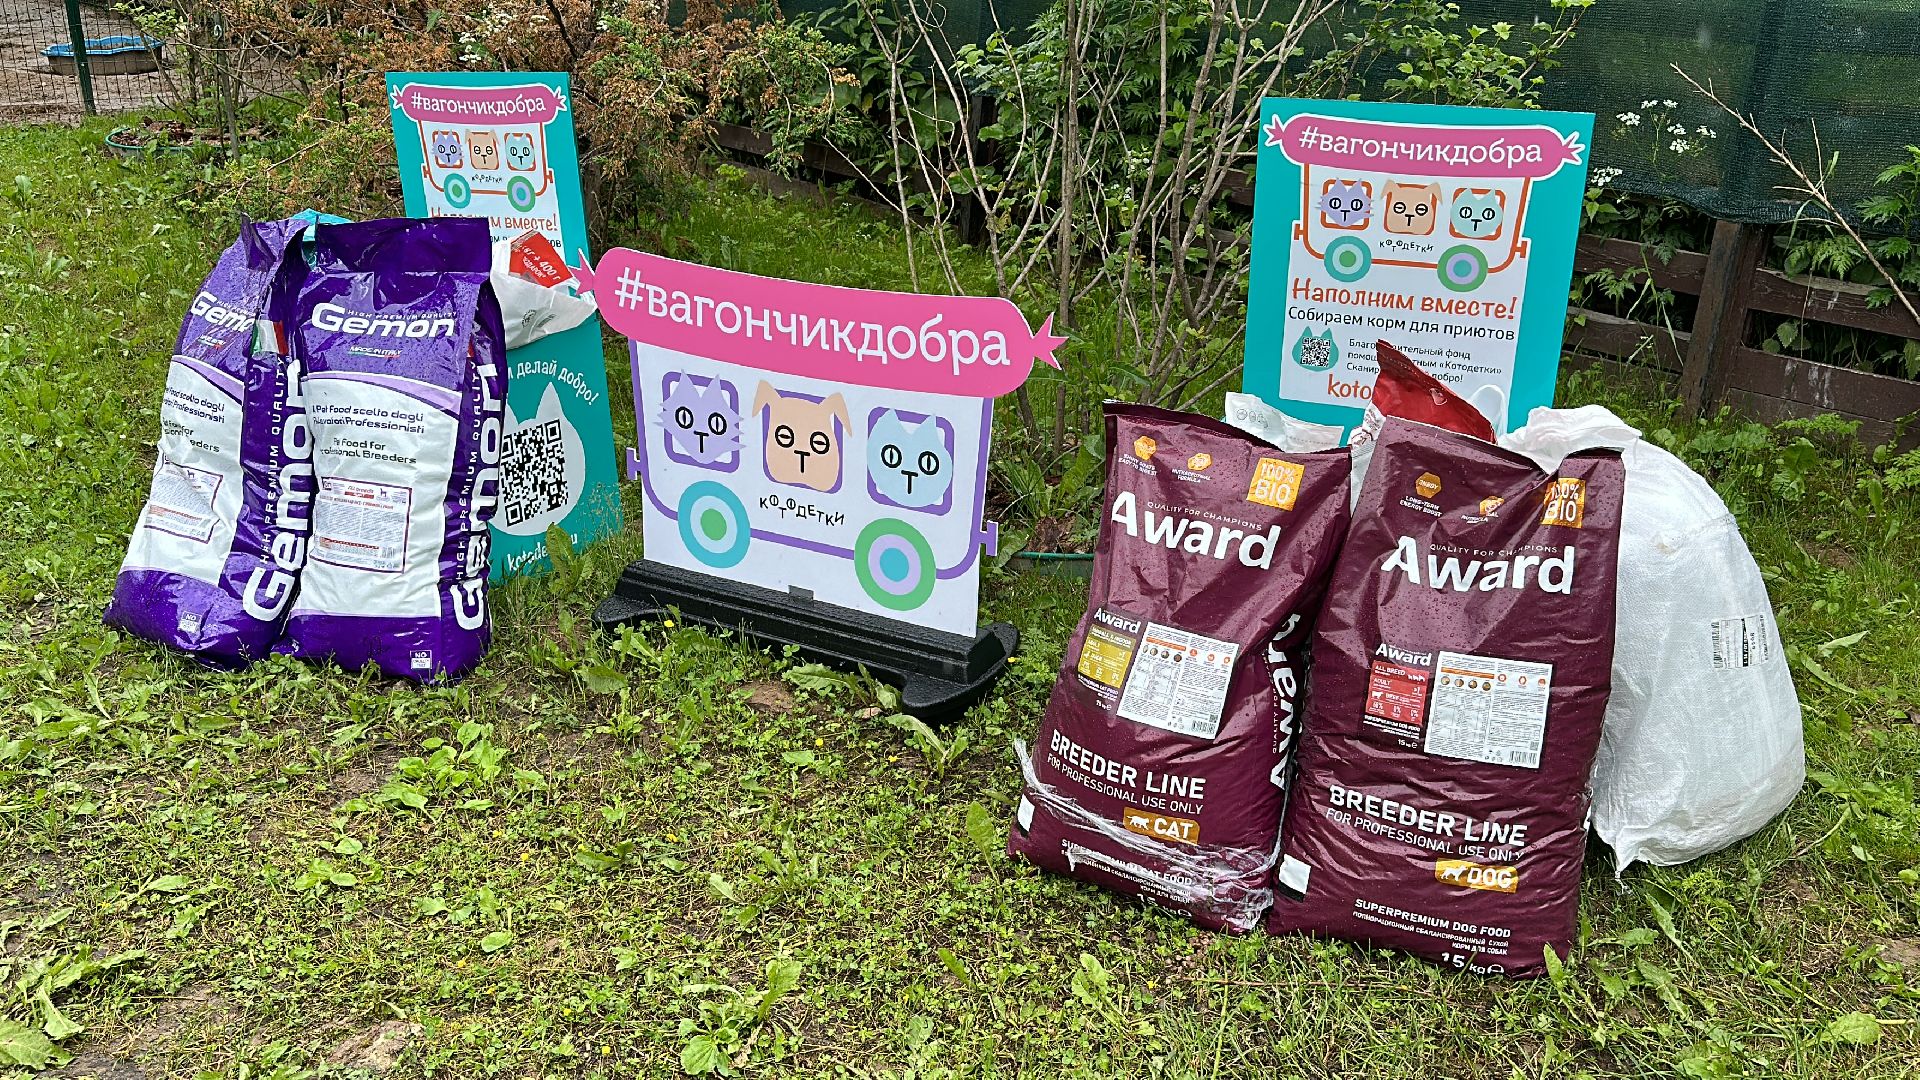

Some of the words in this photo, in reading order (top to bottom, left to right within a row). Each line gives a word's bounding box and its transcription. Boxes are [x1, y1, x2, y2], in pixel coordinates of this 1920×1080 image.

[411, 92, 546, 117] #вагончикдобра
[1299, 126, 1543, 168] #вагончикдобра
[506, 213, 558, 231] вместе!
[540, 261, 557, 275] 400
[1292, 278, 1414, 310] Наполним
[1421, 297, 1517, 320] вместе!
[312, 302, 455, 338] Gemon
[347, 309, 373, 318] HIGH
[614, 267, 1011, 375] #вагончикдобра
[1288, 307, 1363, 325] Собираем
[1367, 317, 1405, 334] корм
[1409, 320, 1439, 333] для
[1444, 325, 1515, 341] приютов
[1349, 338, 1443, 356] Благоительный
[1446, 349, 1471, 360] фонд
[1347, 362, 1380, 374] Сканир
[1440, 361, 1502, 375] «Котодетки»
[516, 360, 557, 379] делай
[558, 367, 599, 406] добро!
[200, 398, 225, 413] dagli
[271, 356, 285, 435] QUALITY
[470, 361, 481, 441] QUALITY
[329, 405, 351, 413] Food
[353, 407, 389, 418] scelto
[391, 410, 424, 423] dagli
[345, 417, 424, 434] Professionisti
[342, 438, 368, 449] Food
[370, 441, 386, 451] for
[363, 450, 417, 464] Breeders
[1260, 463, 1295, 483] 100%
[458, 451, 478, 532] PREMIUM
[1255, 479, 1291, 504] BIO
[1147, 501, 1182, 513] QUALITY
[1184, 507, 1200, 517] FOR
[1203, 511, 1262, 531] CHAMPIONS
[1544, 499, 1577, 522] BIO
[1112, 491, 1282, 570] Award
[455, 540, 467, 580] HIGH
[1429, 543, 1469, 554] QUALITY
[1473, 549, 1494, 557] FOR
[1498, 545, 1558, 557] CHPIONS
[1381, 535, 1575, 595] Award
[1093, 607, 1141, 634] Award
[1375, 643, 1432, 667] Award
[1375, 664, 1386, 672] ALL
[1050, 729, 1137, 788] BREEDER
[1145, 771, 1207, 800] LINE
[1047, 752, 1061, 769] FOR
[1061, 763, 1138, 804] PROFESSIONAL
[1142, 794, 1166, 810] USE
[1169, 801, 1204, 815] ONLY
[1153, 817, 1193, 838] CAT
[1329, 785, 1456, 837] BREEDER
[1464, 816, 1528, 847] LINE
[1325, 807, 1352, 826] FOR
[1354, 816, 1454, 854] PROFESSIONAL
[1459, 845, 1485, 858] USE
[1163, 871, 1193, 885] FOOD
[1466, 866, 1512, 889] DOG
[1354, 898, 1450, 930] SUPERPREMIUM
[1452, 921, 1478, 934] DOG
[1480, 926, 1512, 938] FOOD
[1452, 941, 1470, 951] КОРМ
[1487, 947, 1508, 956] СОБАК
[1441, 952, 1466, 968] 15
[1469, 963, 1486, 975] kg
